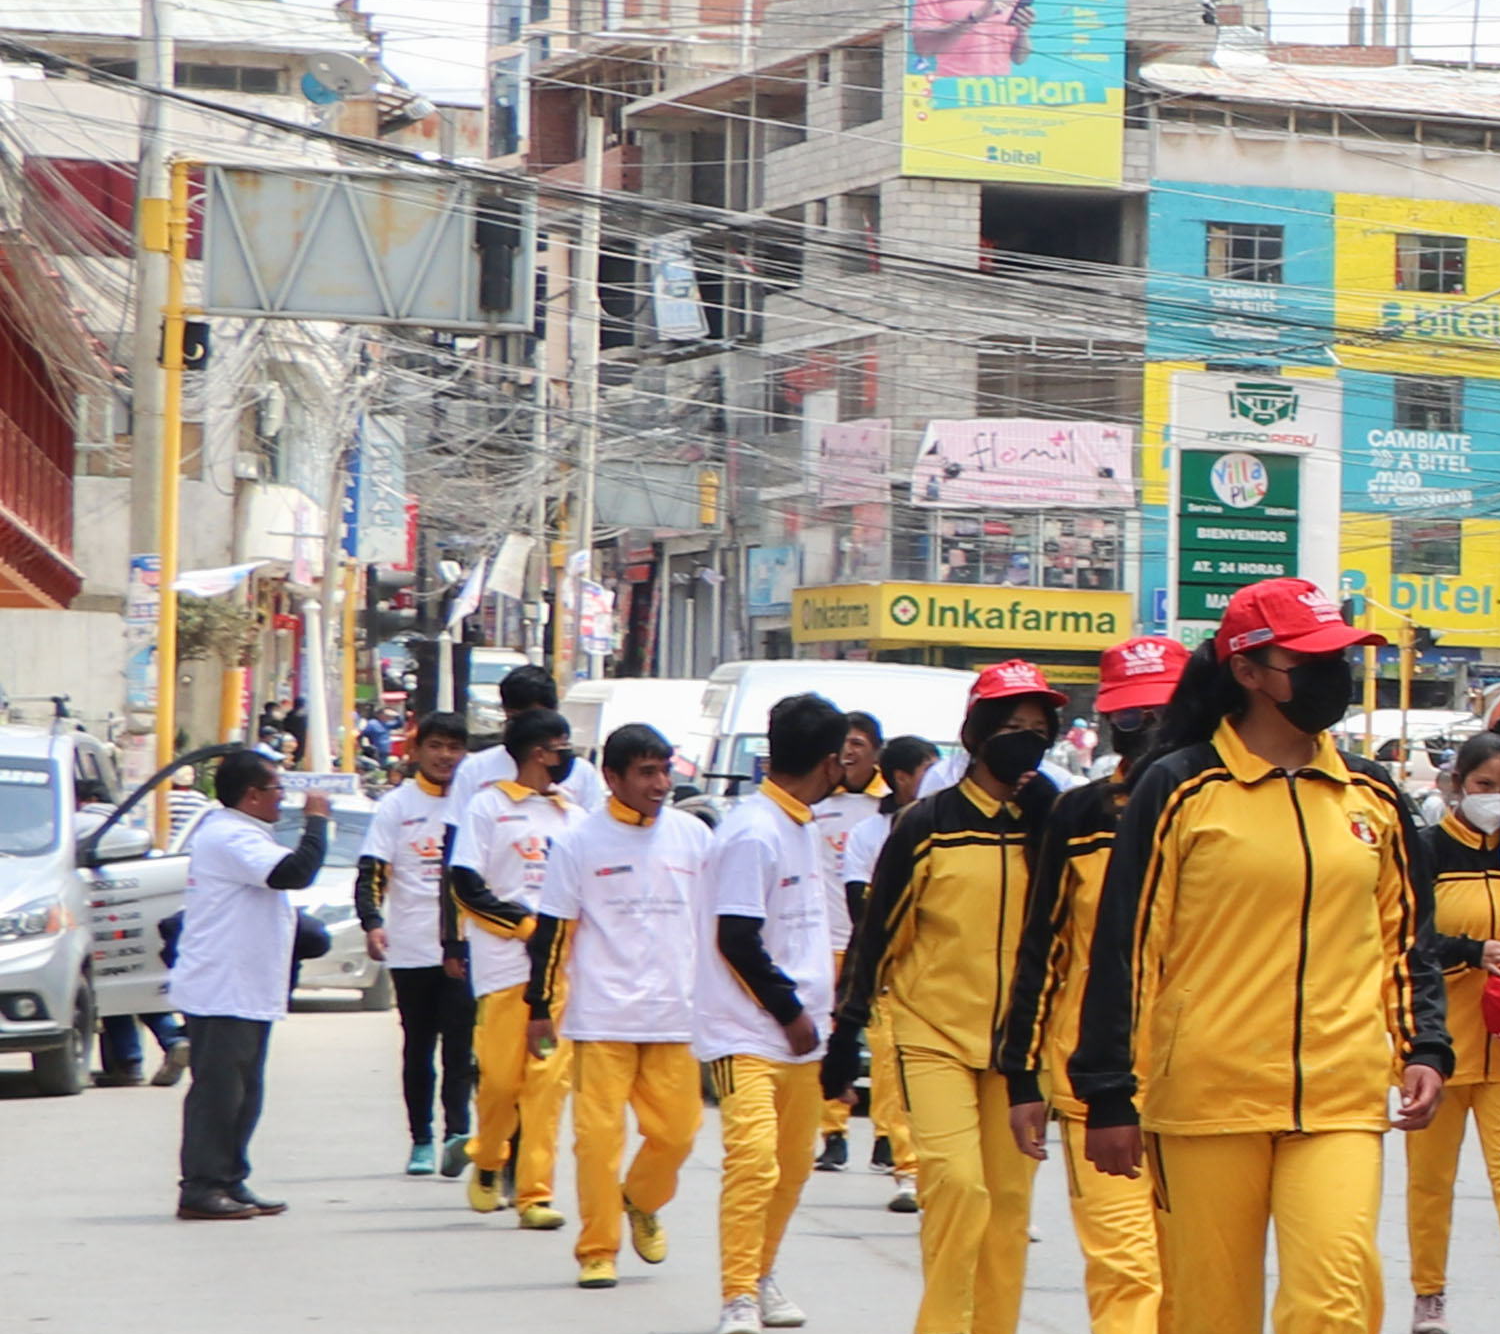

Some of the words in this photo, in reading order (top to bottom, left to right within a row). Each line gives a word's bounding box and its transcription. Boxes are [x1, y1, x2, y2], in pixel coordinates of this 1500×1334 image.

[1000, 150, 1041, 165] bitel
[1367, 430, 1473, 452] CAMBIATE
[1399, 454, 1414, 471] A
[1419, 453, 1473, 472] BITEL
[1197, 527, 1288, 543] BIENVENIDOS
[1218, 560, 1236, 574] 24
[1237, 561, 1284, 575] HORAS
[1390, 575, 1493, 616] bitel
[927, 597, 1116, 634] Inkafarma
